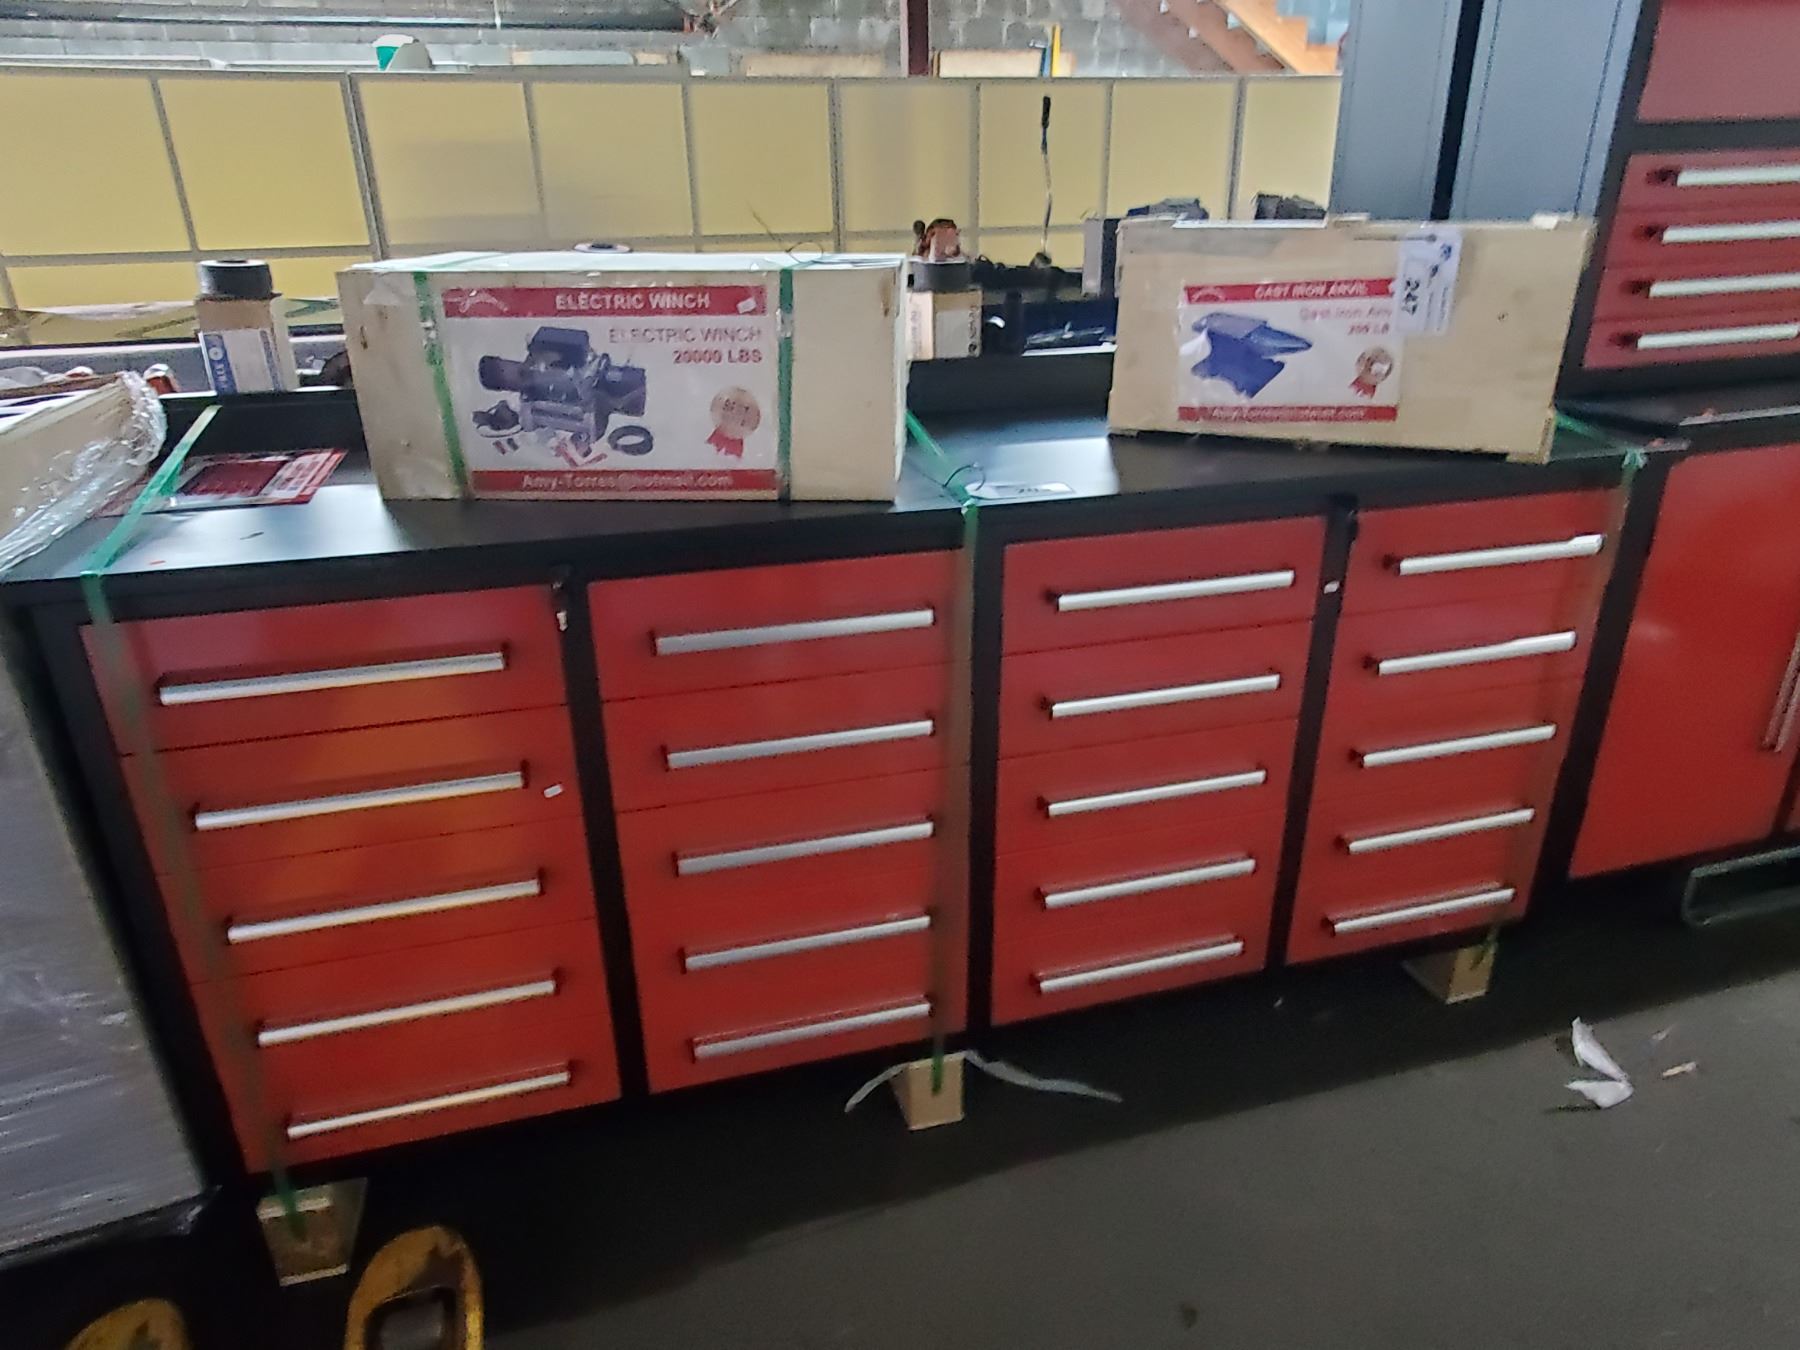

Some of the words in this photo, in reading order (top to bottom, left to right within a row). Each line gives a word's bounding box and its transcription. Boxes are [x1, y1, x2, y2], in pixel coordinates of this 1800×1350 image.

[555, 292, 645, 310] ELECTRIC
[649, 292, 710, 309] WINCH
[608, 327, 698, 343] ELECTRIC
[700, 326, 762, 342] WINCH
[673, 349, 722, 364] 20000
[727, 348, 763, 364] LBS
